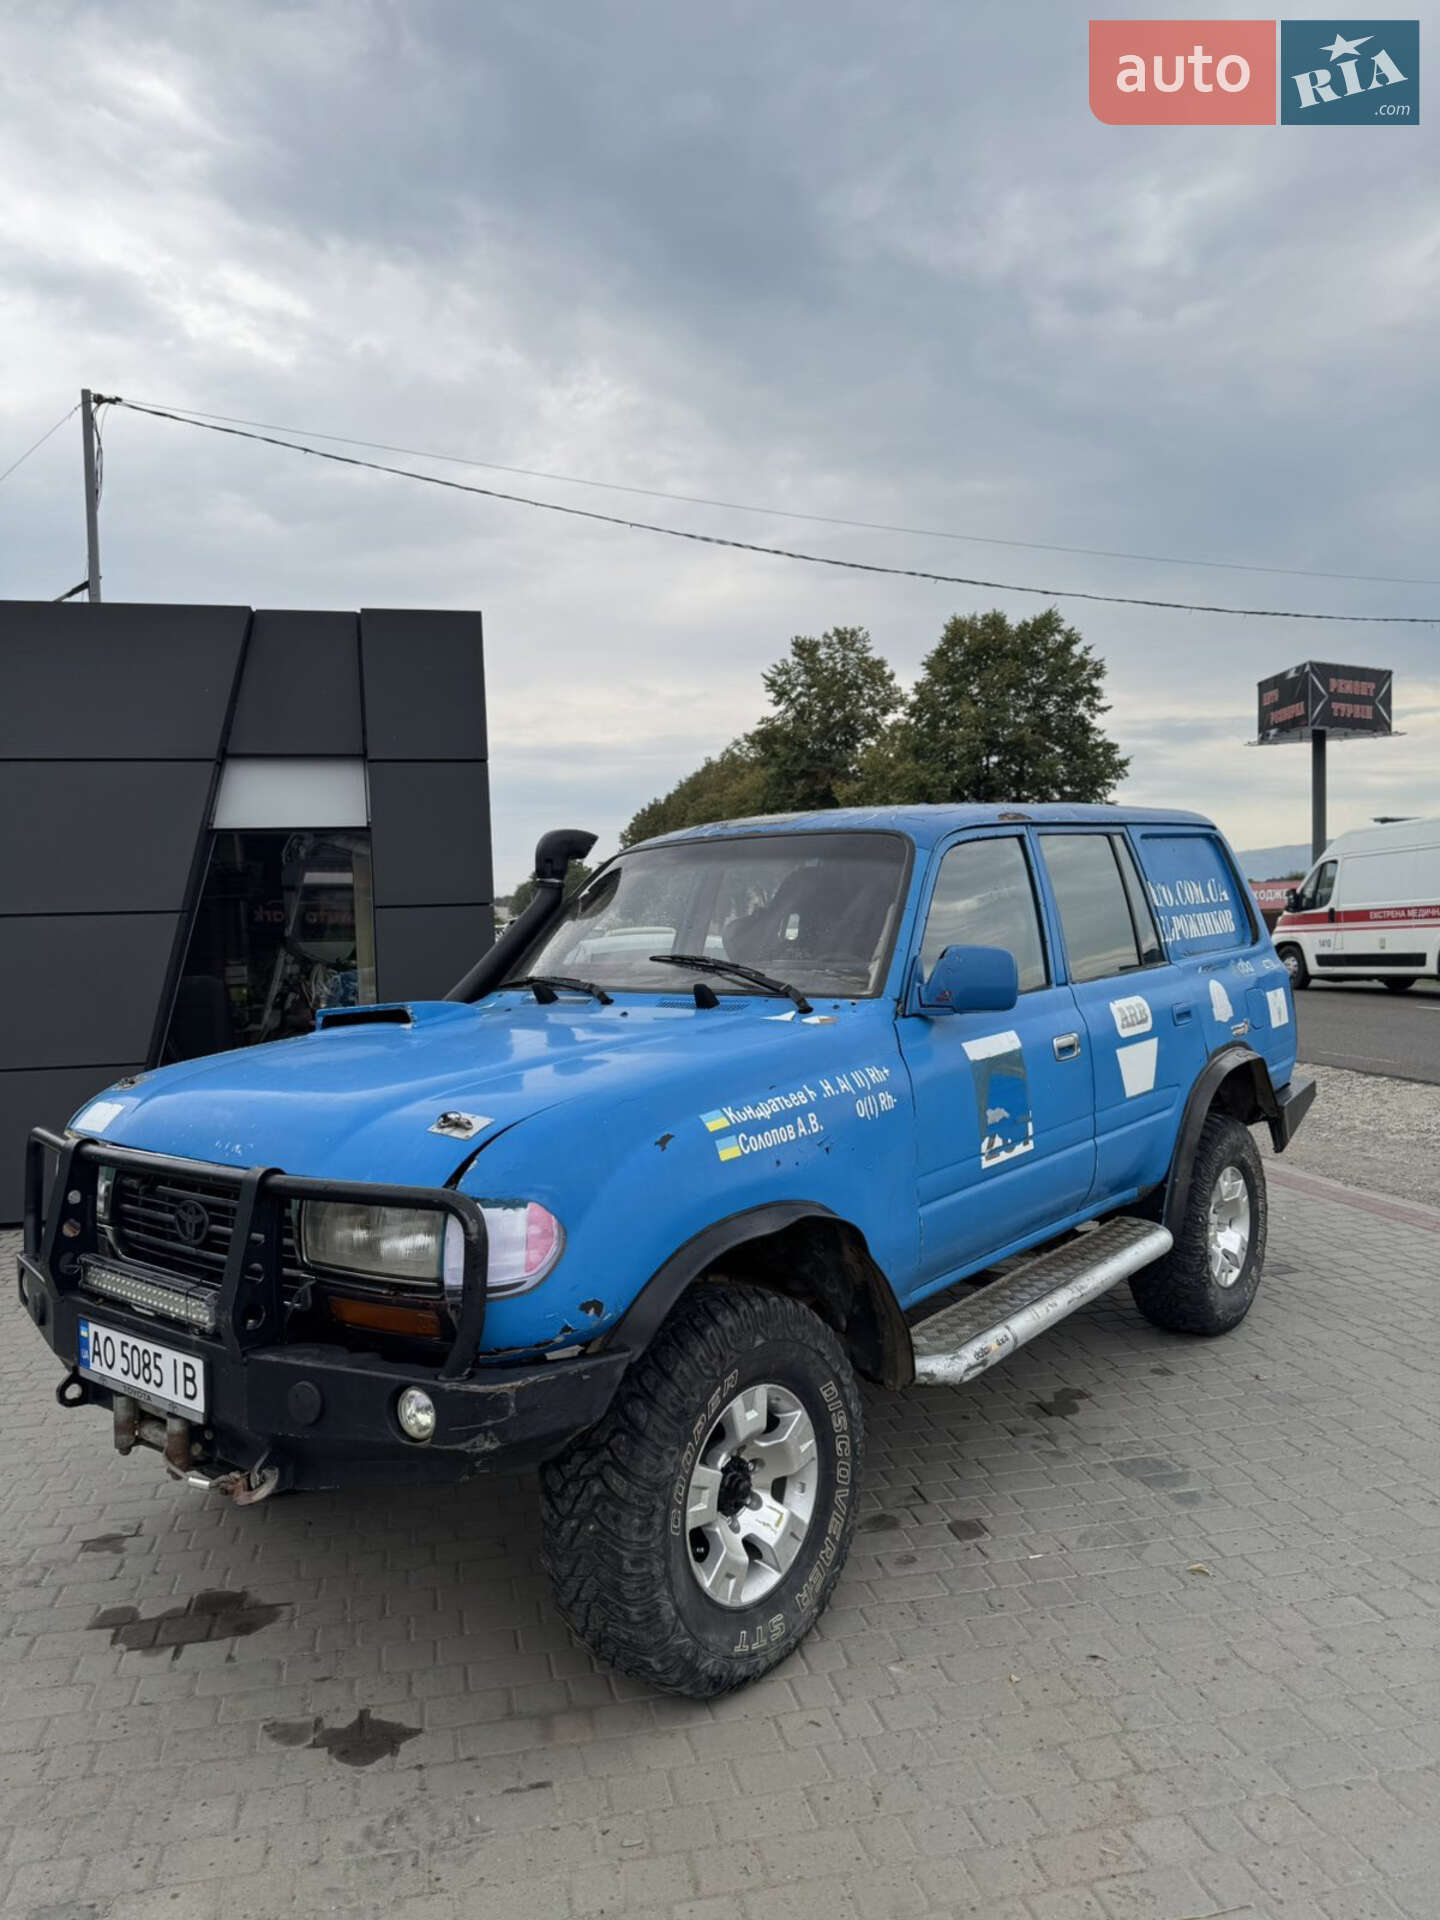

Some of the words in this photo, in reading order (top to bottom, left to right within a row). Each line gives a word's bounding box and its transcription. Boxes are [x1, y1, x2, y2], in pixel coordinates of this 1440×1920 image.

[1369, 910, 1406, 921] ЕКСТРЕНА
[738, 1124, 796, 1155] Солопов
[91, 1331, 116, 1370] AO
[120, 1340, 163, 1388] 5085
[173, 1358, 198, 1401] IB
[795, 1380, 852, 1611] DISCOVERER
[733, 1613, 786, 1653] STT
